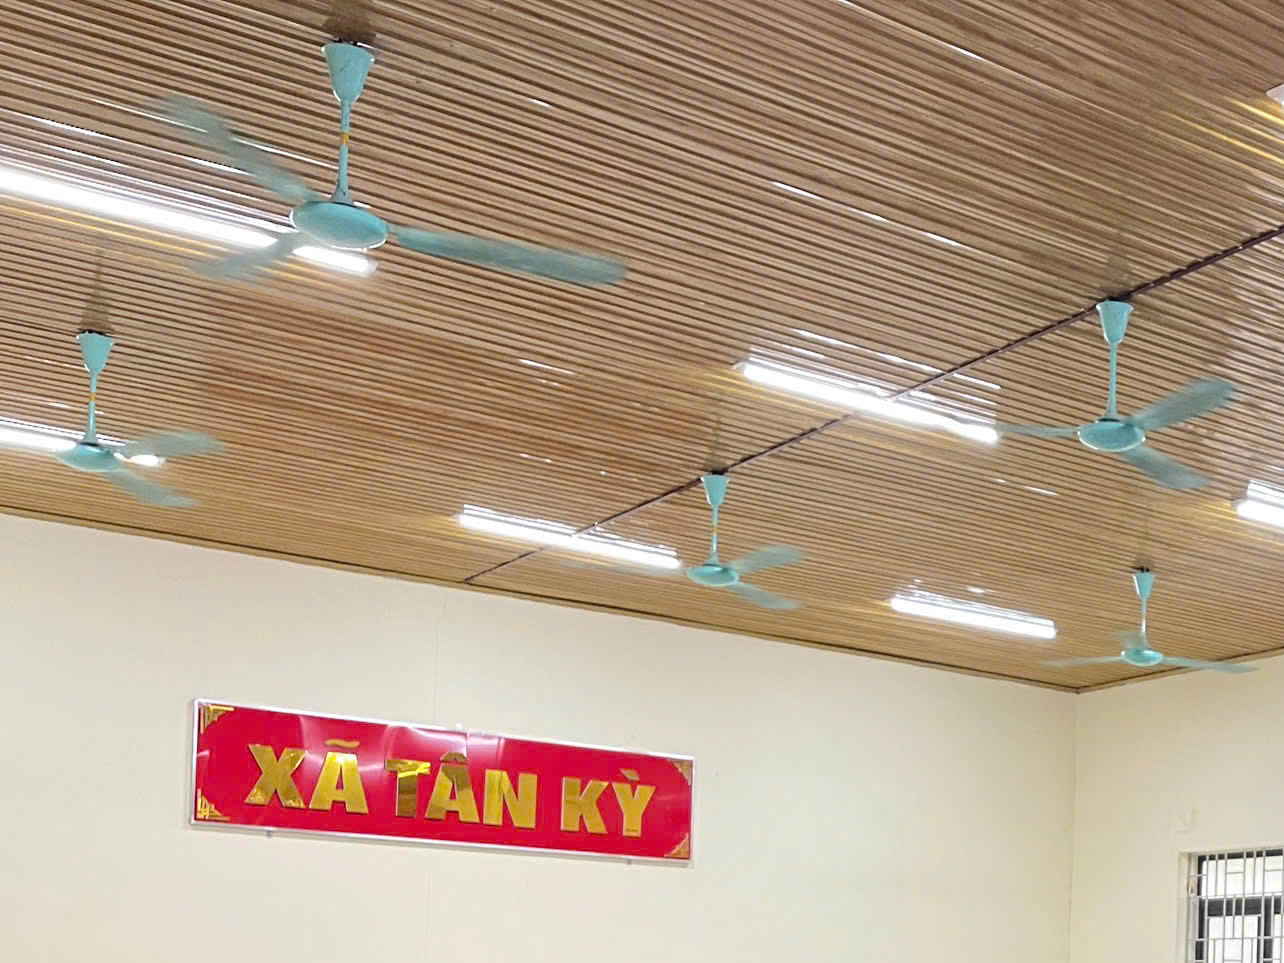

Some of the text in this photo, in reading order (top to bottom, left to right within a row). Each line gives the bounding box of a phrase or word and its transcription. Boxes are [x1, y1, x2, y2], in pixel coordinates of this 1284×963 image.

[244, 739, 656, 838] XÃ TÂN KỲ
